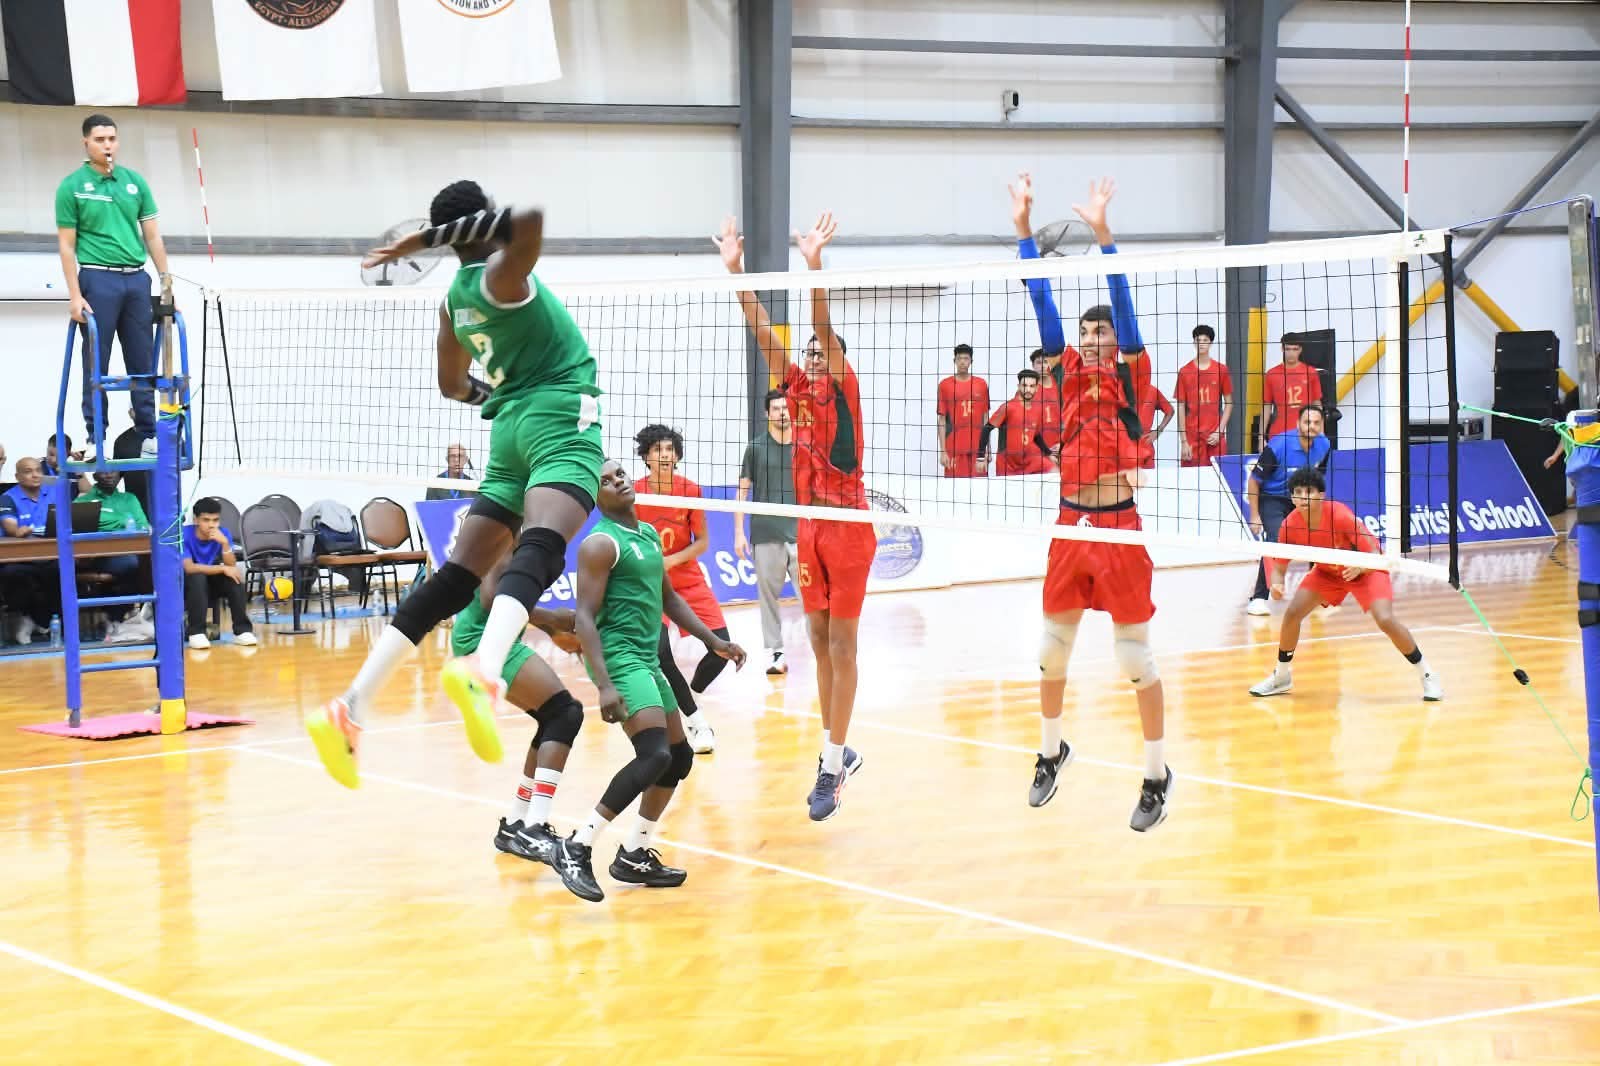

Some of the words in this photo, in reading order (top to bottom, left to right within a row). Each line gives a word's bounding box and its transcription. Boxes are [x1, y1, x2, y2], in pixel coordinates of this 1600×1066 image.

[469, 333, 505, 389] 2
[1199, 386, 1211, 404] 11
[1287, 385, 1302, 404] 12
[1410, 503, 1465, 536] ritsh
[1462, 497, 1541, 532] School
